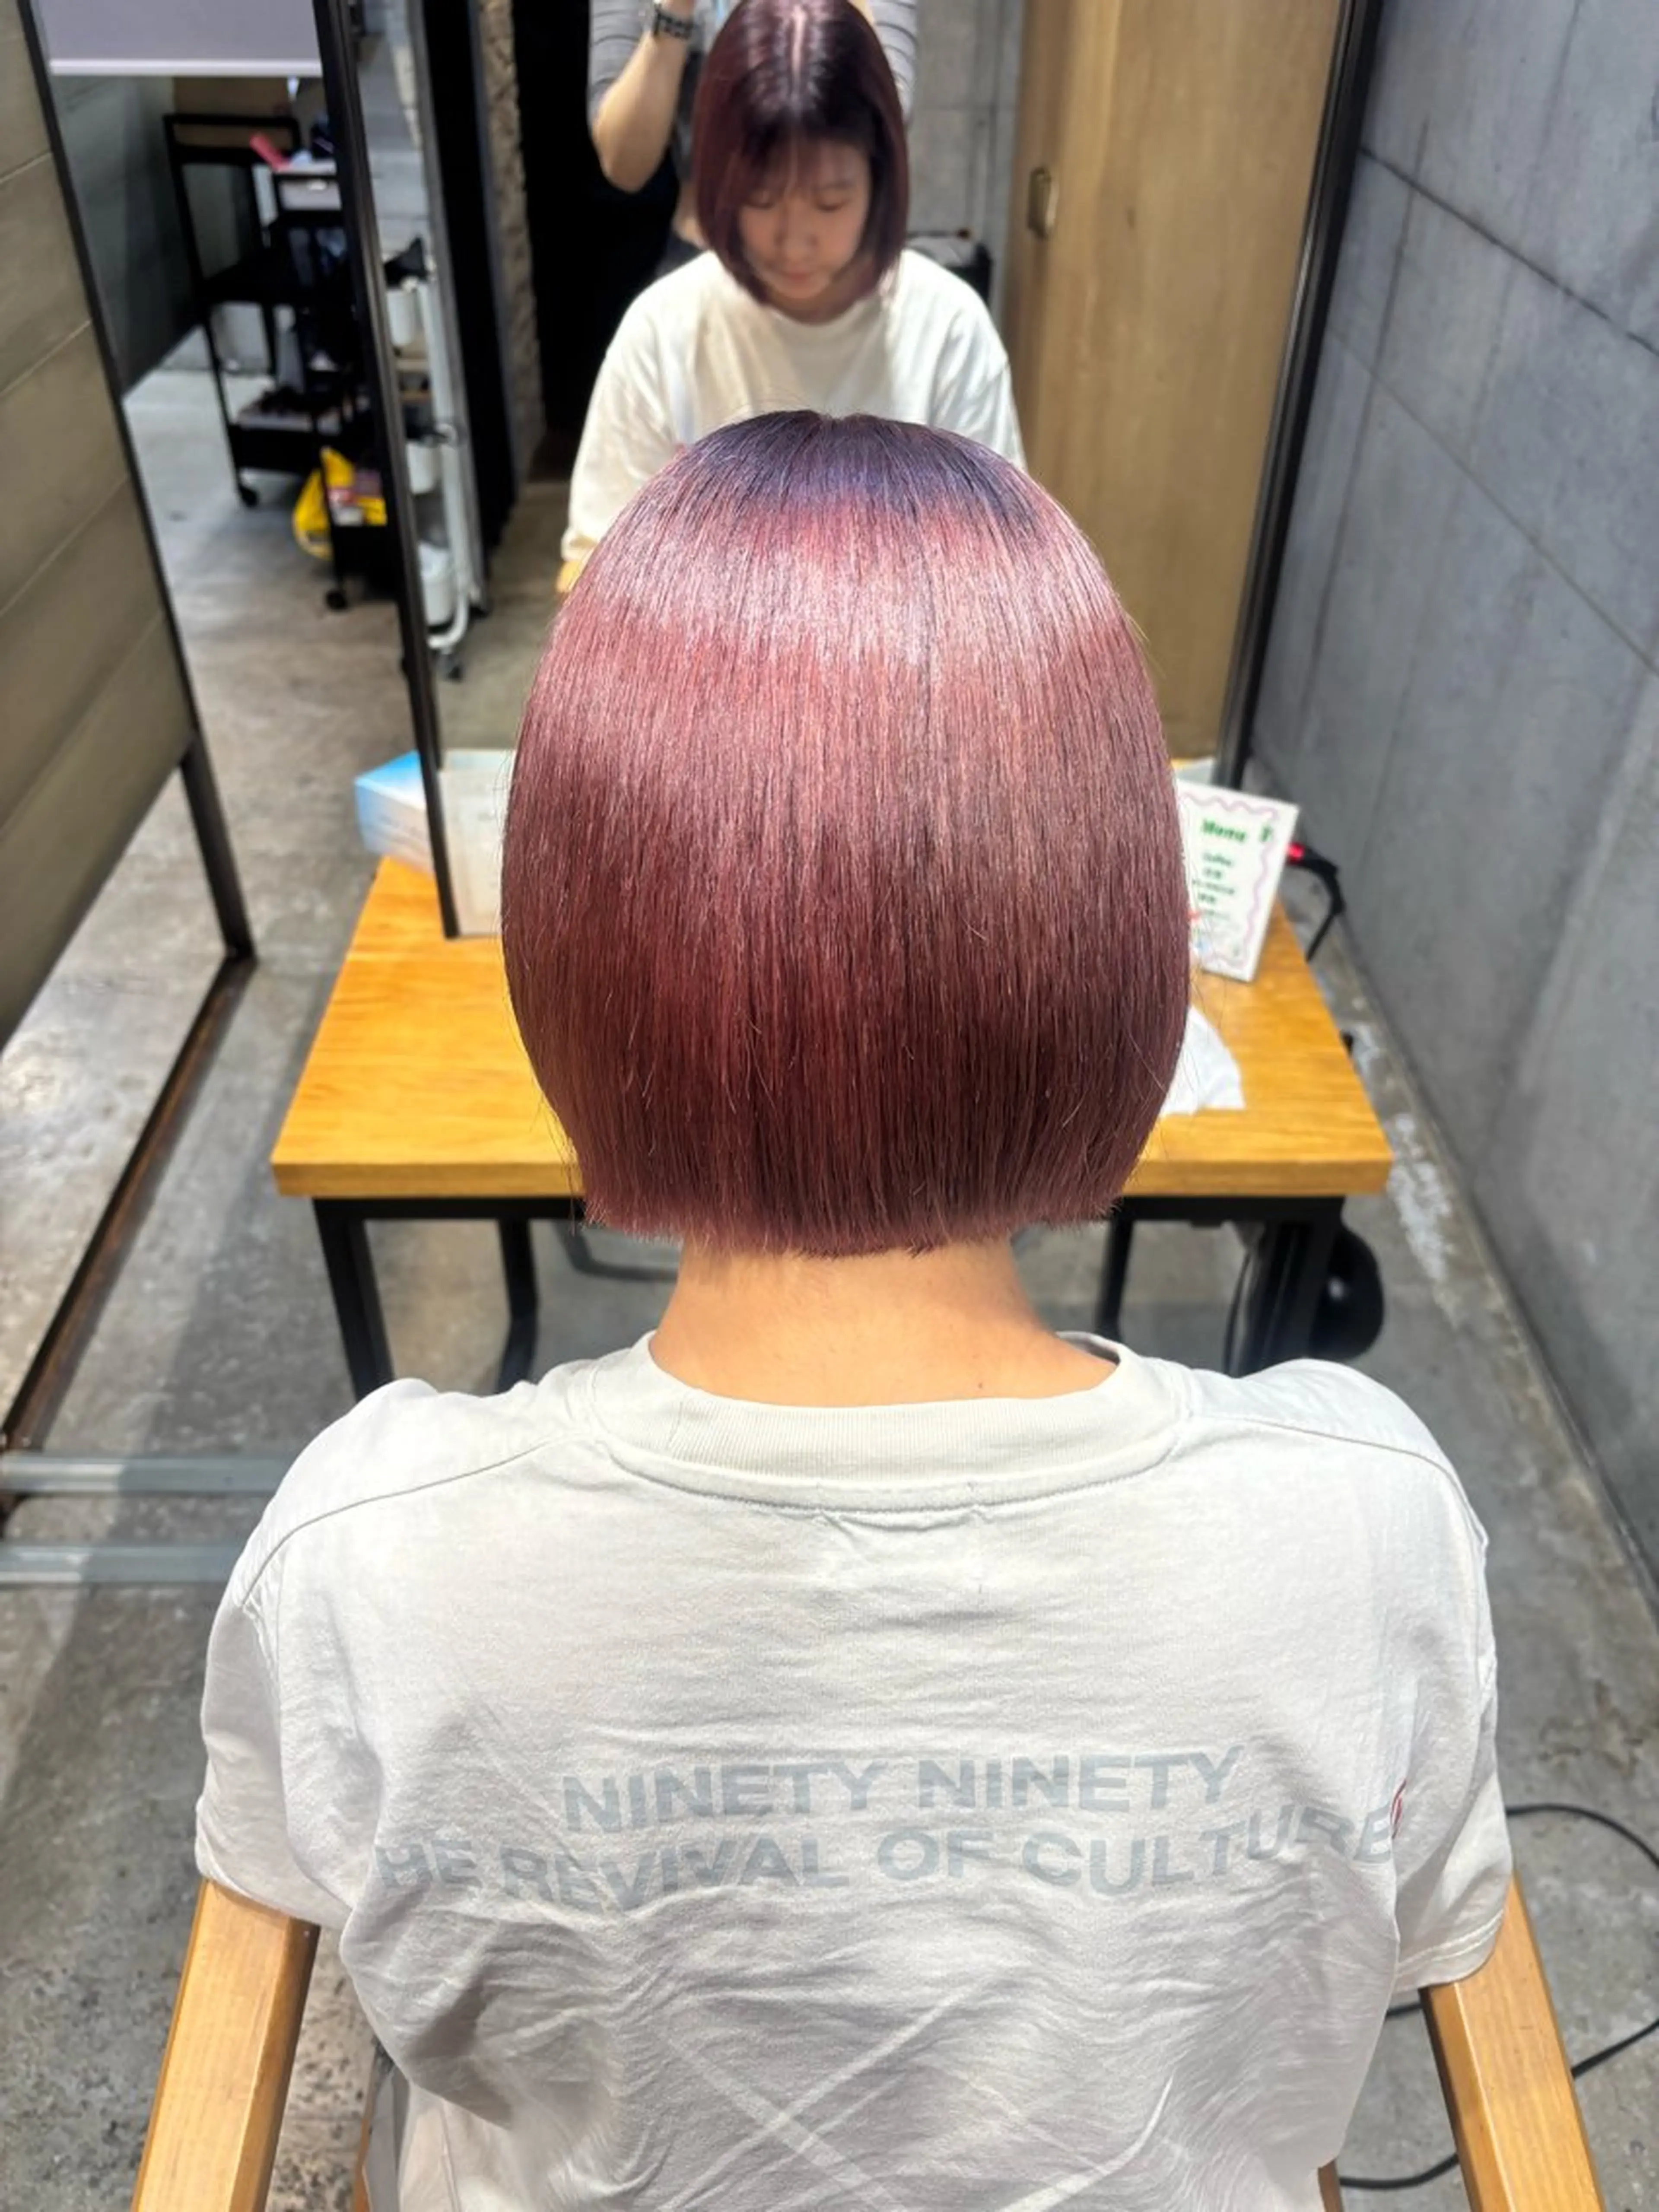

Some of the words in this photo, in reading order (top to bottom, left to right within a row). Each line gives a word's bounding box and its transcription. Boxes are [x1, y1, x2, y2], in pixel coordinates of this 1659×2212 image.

[563, 1760, 887, 1833] NINETY
[918, 1745, 1244, 1810] NINETY
[499, 1836, 849, 1912] REVIVAL
[876, 1829, 994, 1880] OF
[1021, 1802, 1392, 1894] CULTURE
